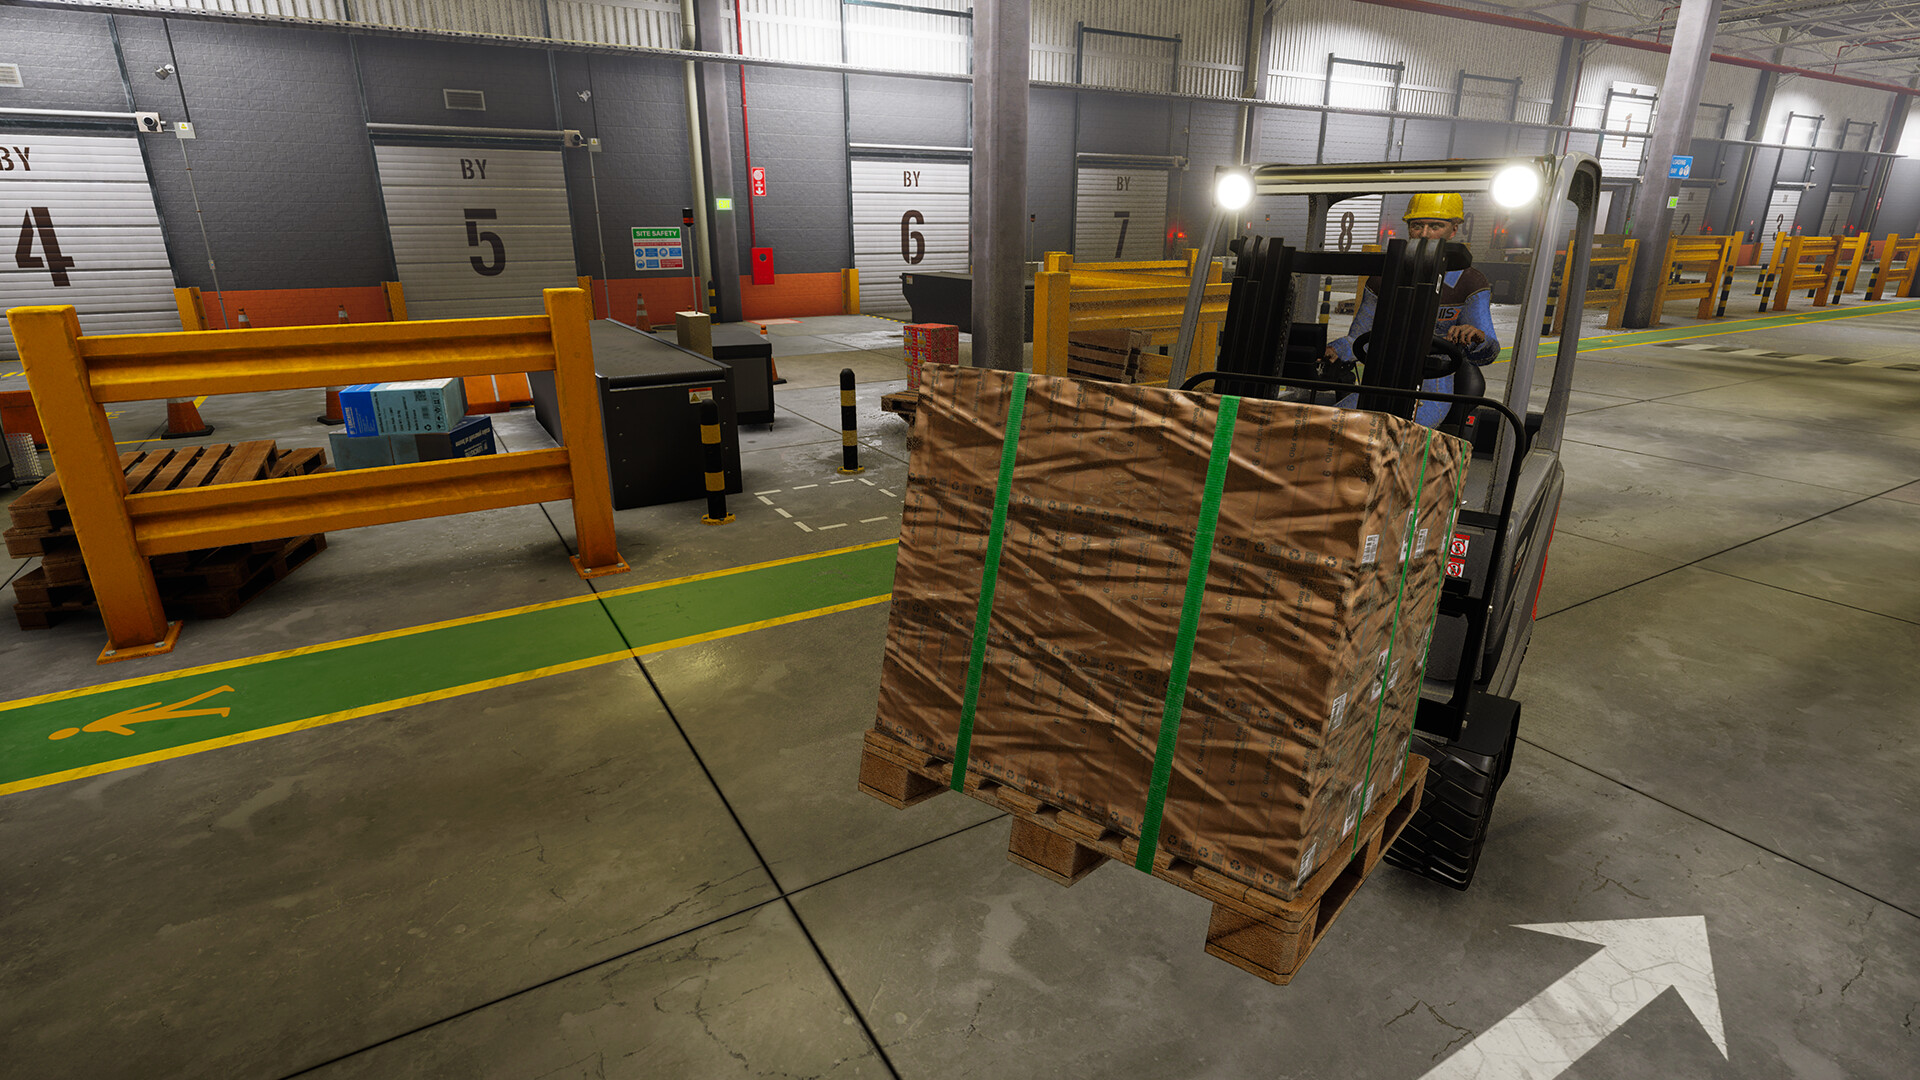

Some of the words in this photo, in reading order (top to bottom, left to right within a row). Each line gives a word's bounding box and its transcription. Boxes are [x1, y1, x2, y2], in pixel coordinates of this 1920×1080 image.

[460, 158, 487, 181] BY
[903, 171, 920, 188] BY
[1116, 176, 1130, 191] BY
[15, 206, 75, 286] 4
[464, 209, 506, 276] 5
[900, 210, 926, 265] 6
[1114, 211, 1130, 258] 7
[1338, 211, 1355, 252] 8
[1772, 213, 1784, 241] 3
